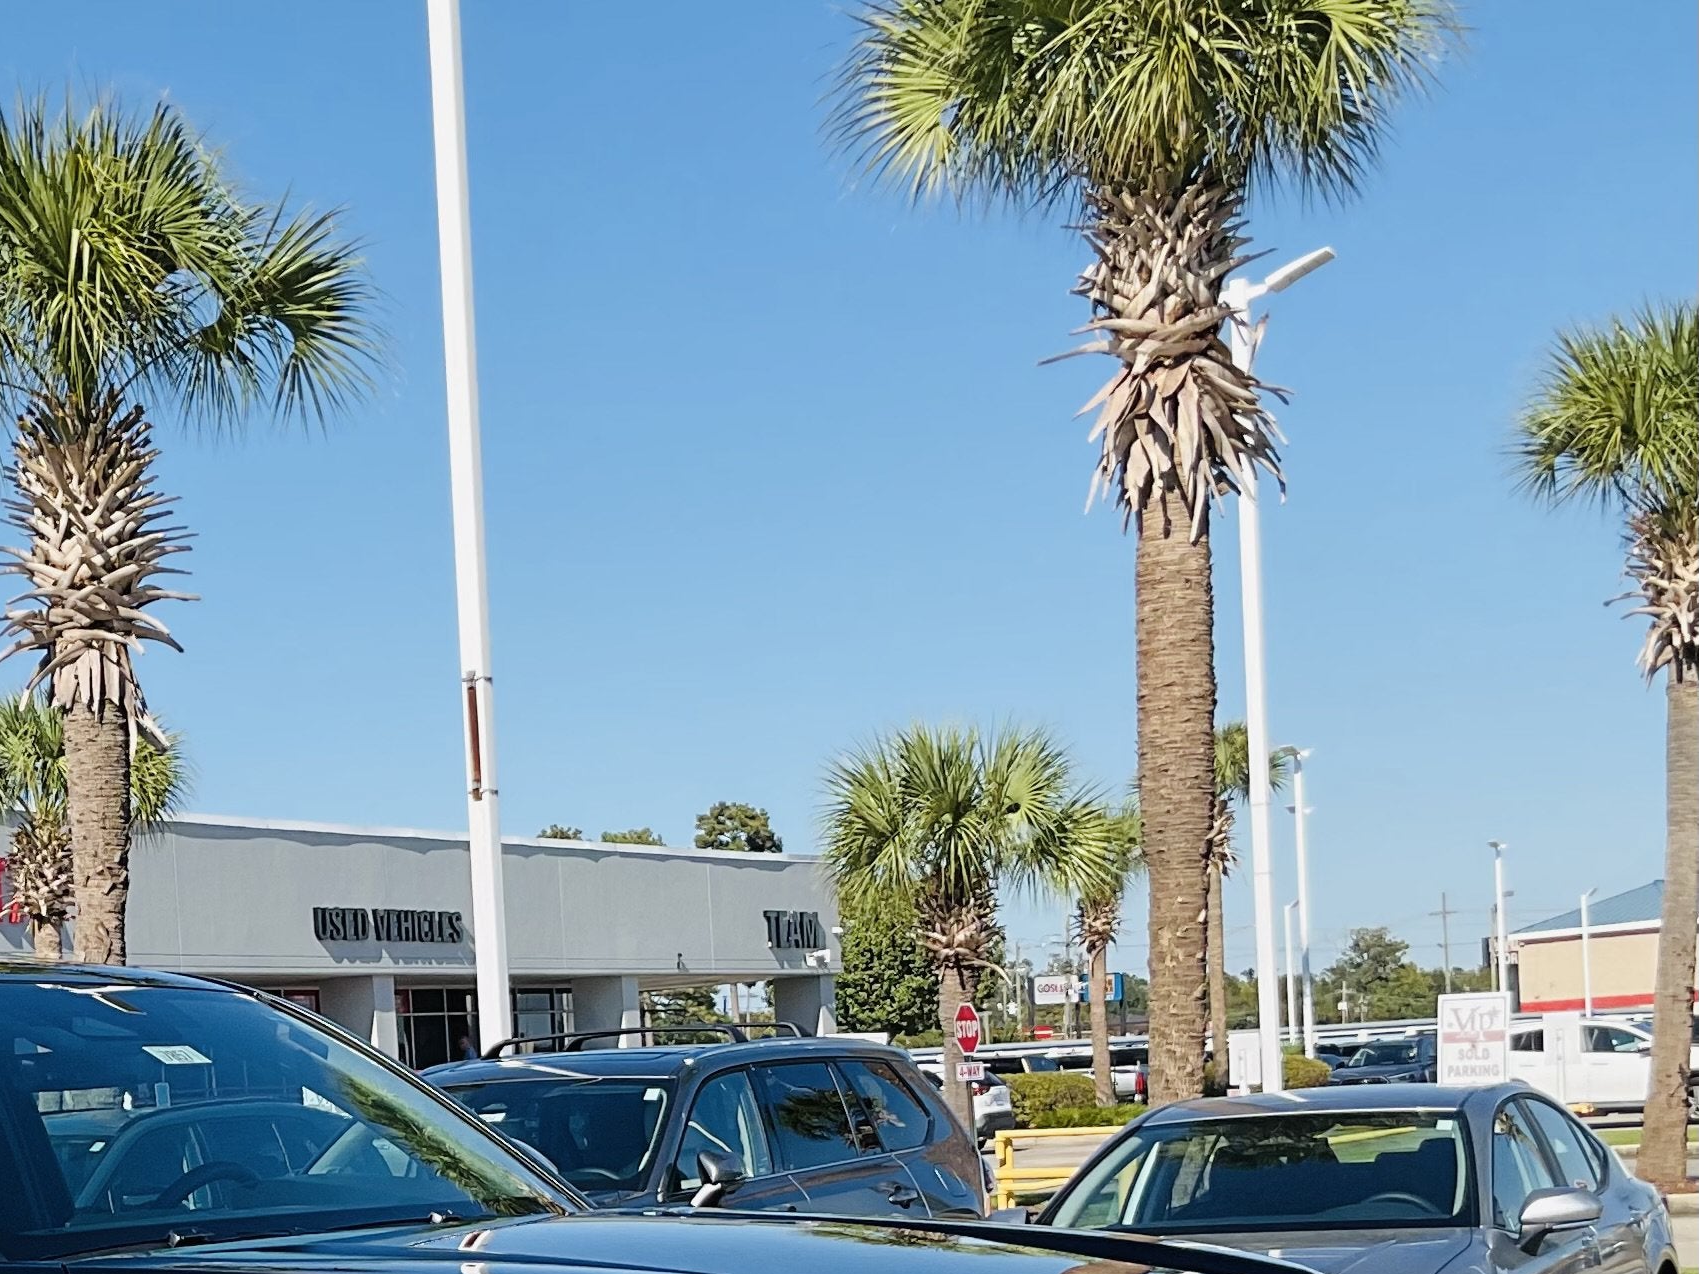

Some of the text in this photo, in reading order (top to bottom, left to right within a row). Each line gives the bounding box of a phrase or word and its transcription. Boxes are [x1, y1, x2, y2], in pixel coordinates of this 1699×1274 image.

[313, 907, 464, 943] USED VEHICLES
[763, 910, 819, 949] TEAM
[956, 1020, 978, 1039] STOP
[1458, 1048, 1490, 1060] SOLD
[959, 1065, 981, 1078] 4-WAY
[1447, 1064, 1500, 1079] PARKING
